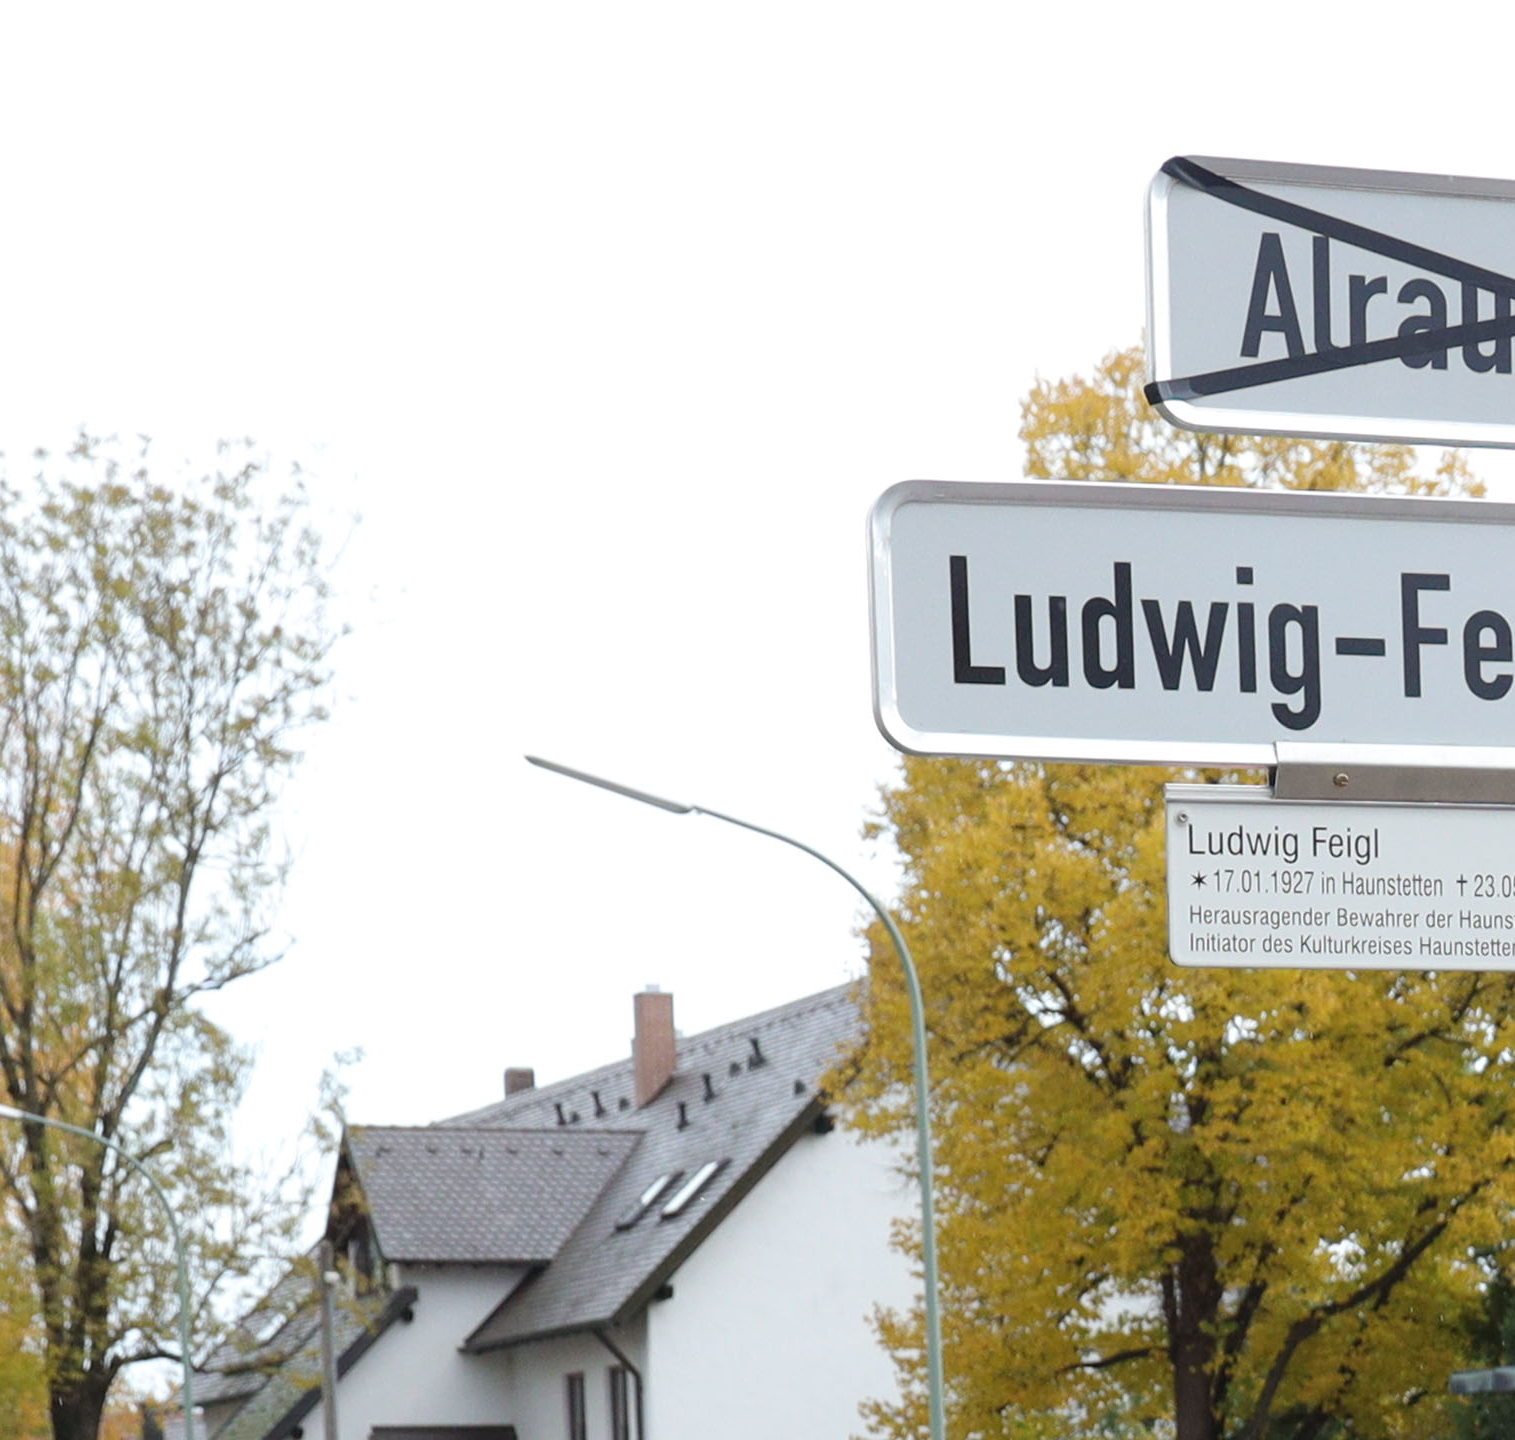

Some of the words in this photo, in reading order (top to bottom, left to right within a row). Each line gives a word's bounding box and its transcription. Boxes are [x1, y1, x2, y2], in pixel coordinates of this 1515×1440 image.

[1187, 824, 1299, 864] Ludwig
[1312, 826, 1379, 866] Feigl
[1214, 870, 1315, 894] 17.01.1927
[1321, 872, 1336, 894] in
[1342, 871, 1443, 897] Haunstetten
[1189, 905, 1331, 930] Herausragender
[1337, 907, 1420, 928] Bewahrer
[1425, 909, 1453, 929] der
[1189, 933, 1256, 953] Initiator
[1262, 935, 1293, 954] des
[1300, 935, 1413, 955] Kulturkreises
